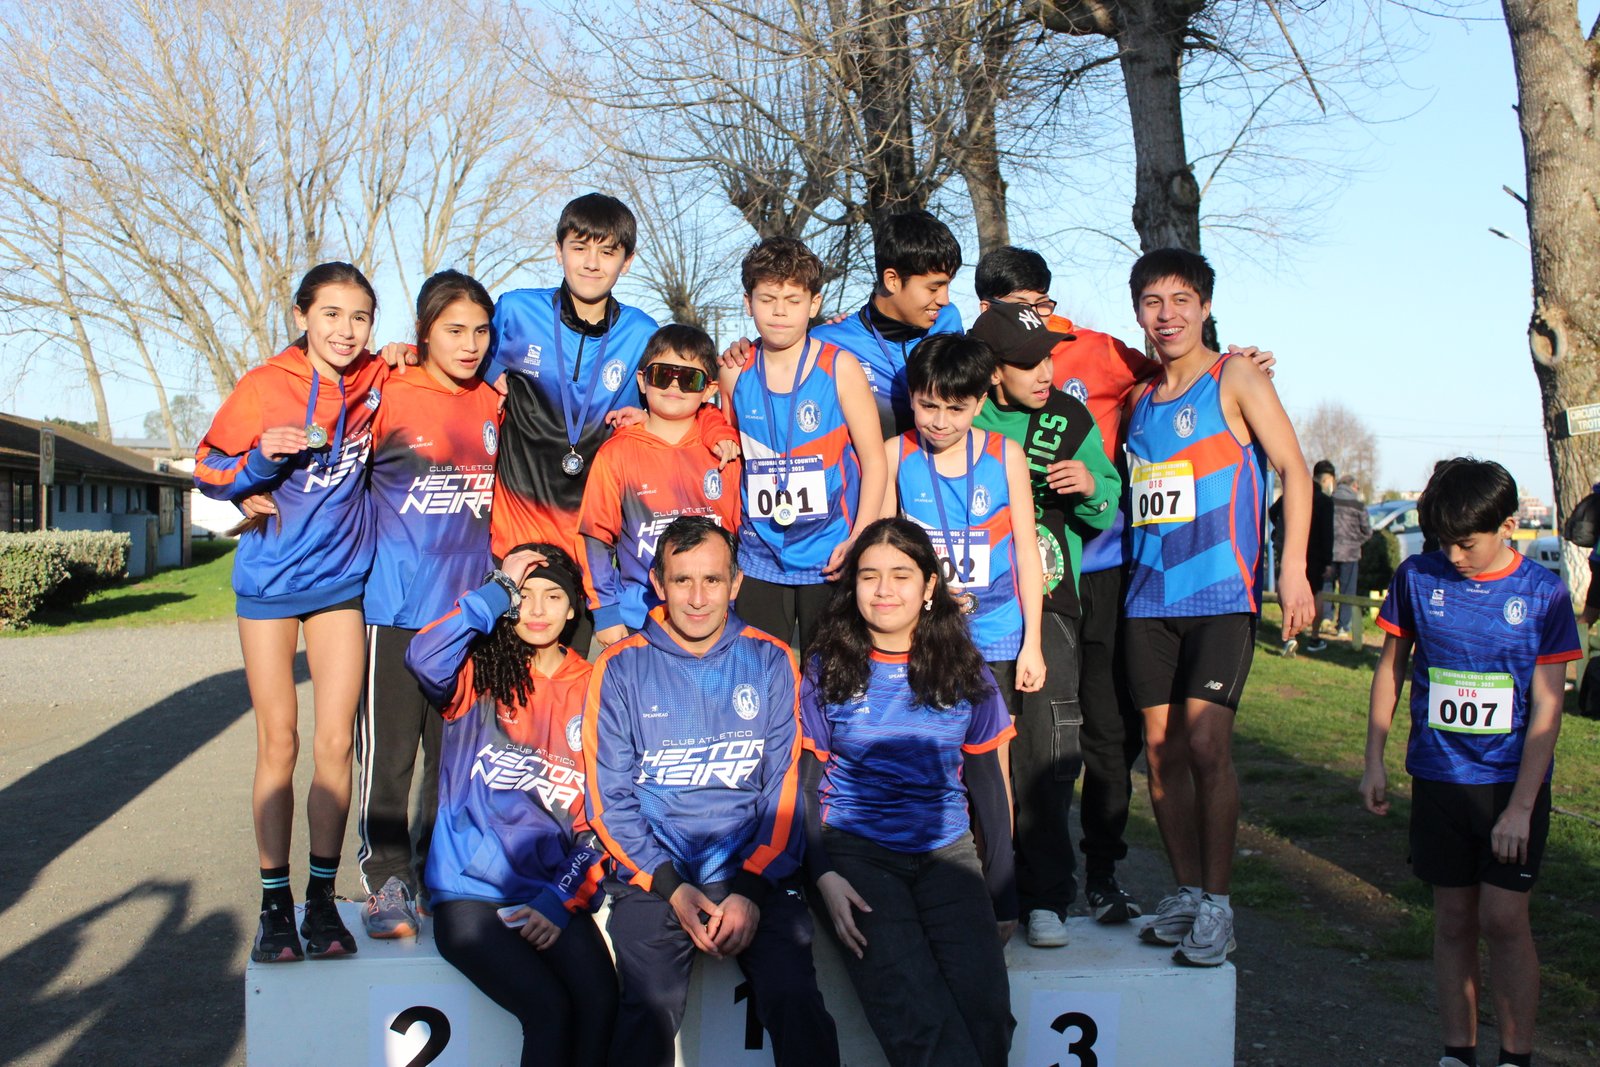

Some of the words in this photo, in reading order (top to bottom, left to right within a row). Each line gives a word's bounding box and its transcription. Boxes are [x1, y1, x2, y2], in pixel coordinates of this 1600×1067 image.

[429, 465, 453, 473] CLUB
[454, 464, 493, 472] ATLETICO
[653, 509, 679, 518] CLUB
[1139, 490, 1181, 519] 007
[1458, 688, 1478, 698] U16
[1440, 699, 1498, 727] 007
[662, 739, 695, 747] CLUB
[698, 730, 753, 745] ATLETICO
[505, 743, 533, 755] CLUB
[535, 748, 576, 767] ATLETICO
[476, 743, 586, 796] HECTOR
[470, 758, 580, 813] NEIRA
[389, 1005, 452, 1067] 2
[1048, 1011, 1099, 1067] 3
